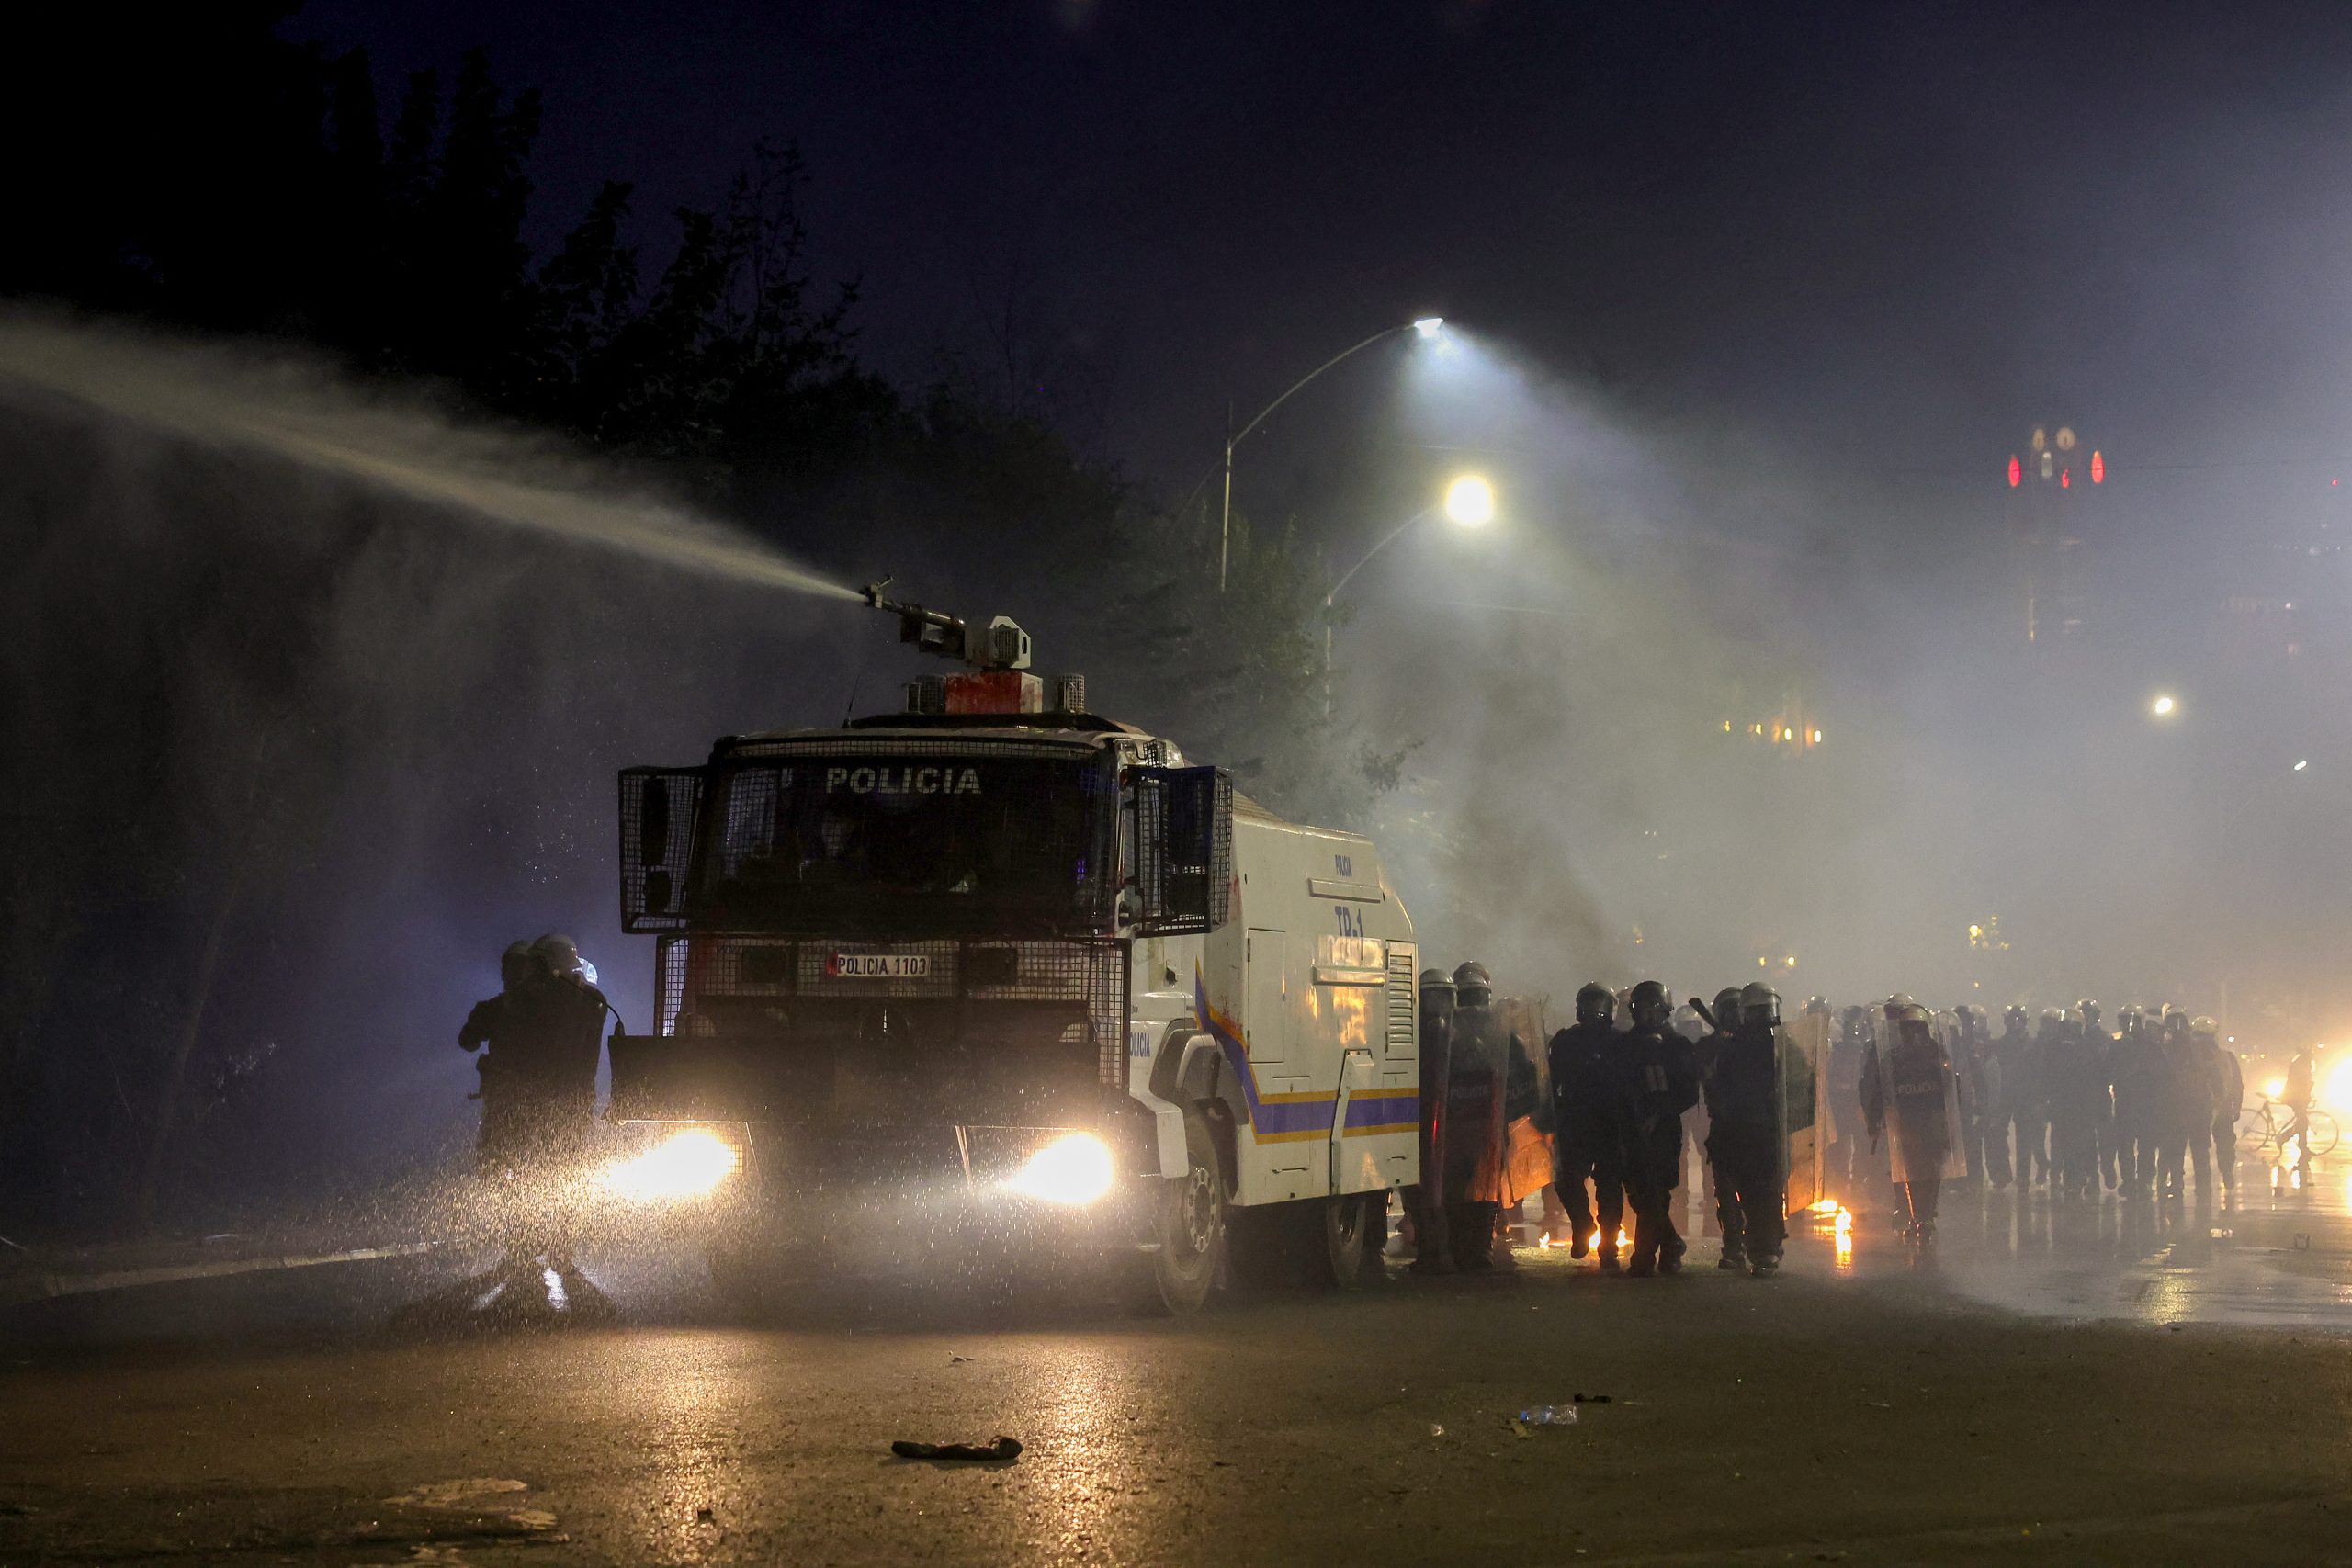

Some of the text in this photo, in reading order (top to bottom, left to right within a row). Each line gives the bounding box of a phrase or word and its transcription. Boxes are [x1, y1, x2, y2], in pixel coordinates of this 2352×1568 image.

[825, 766, 982, 795] POLICIA
[837, 957, 927, 975] POLICIA 1103
[1130, 1031, 1151, 1058] OLICIA
